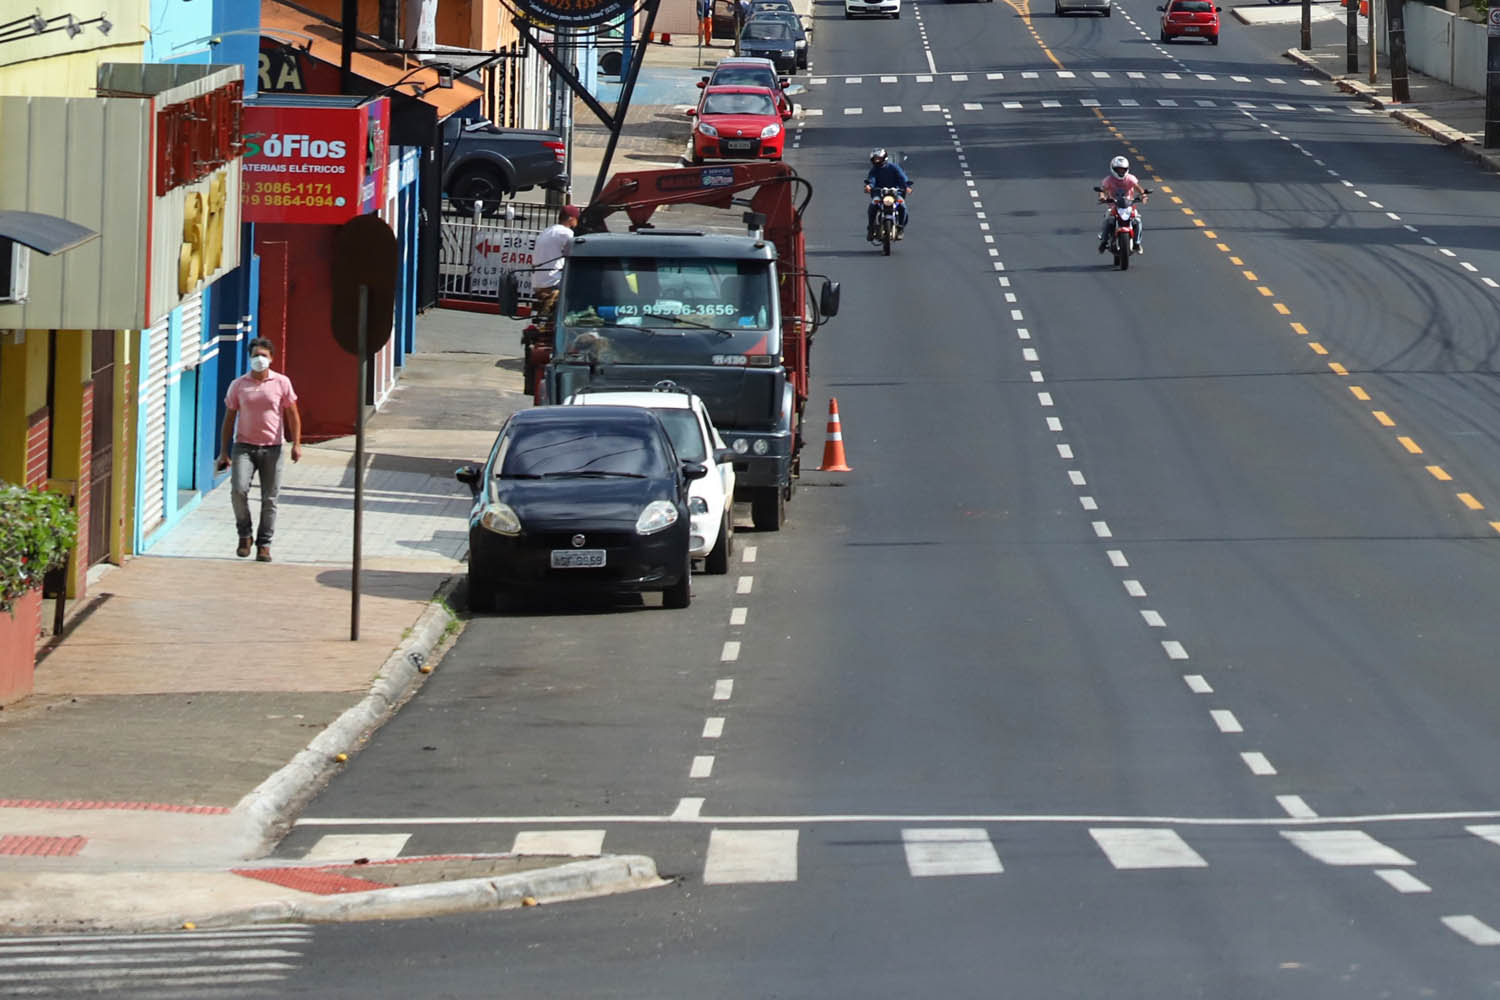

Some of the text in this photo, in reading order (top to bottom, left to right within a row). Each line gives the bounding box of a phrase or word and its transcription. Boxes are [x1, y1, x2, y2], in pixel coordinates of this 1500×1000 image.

[242, 164, 346, 174] ATERIAIS ELÉTRICOS
[255, 182, 332, 194] 3086-1171
[614, 305, 638, 316] (42)
